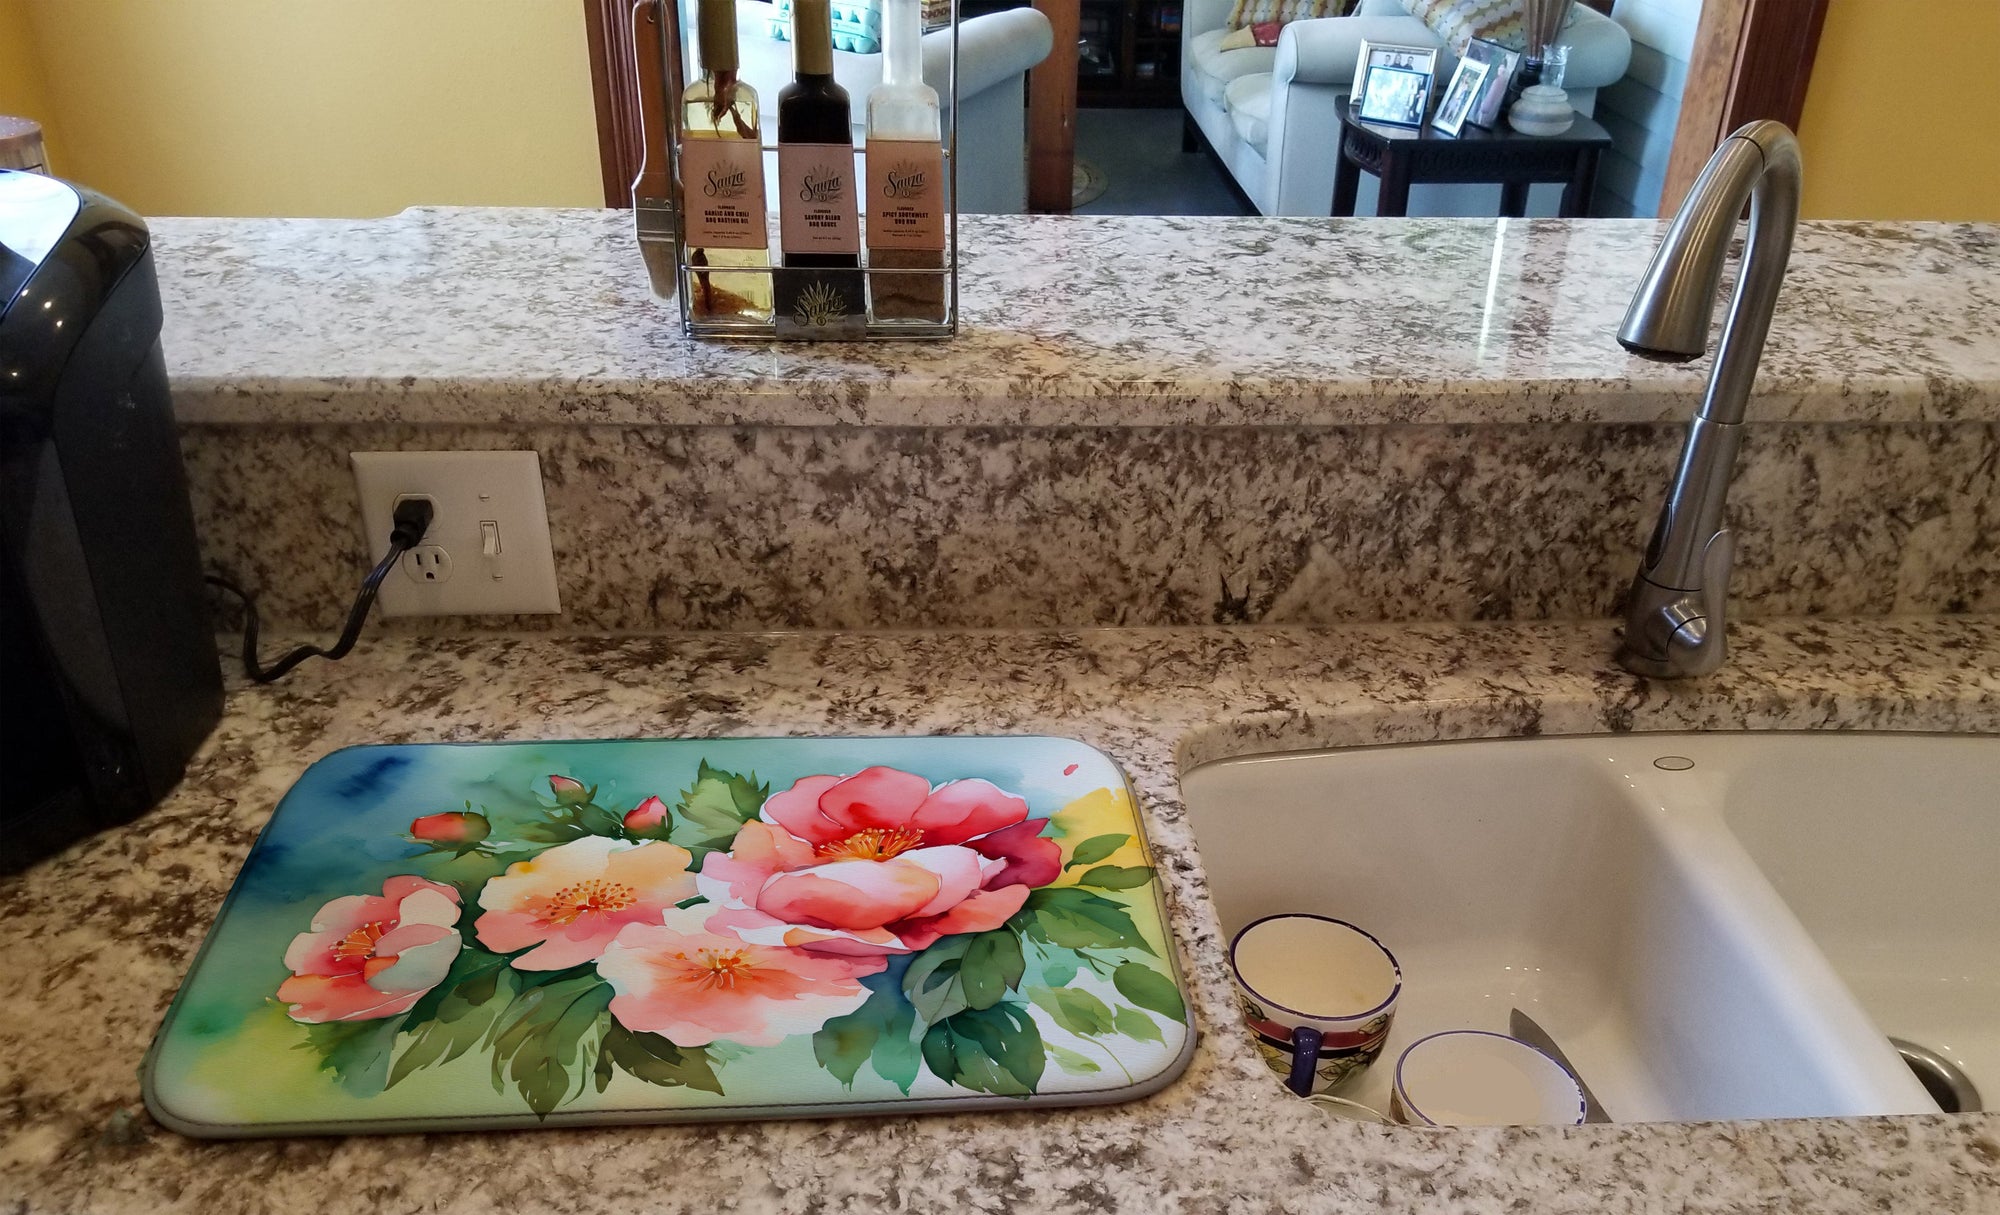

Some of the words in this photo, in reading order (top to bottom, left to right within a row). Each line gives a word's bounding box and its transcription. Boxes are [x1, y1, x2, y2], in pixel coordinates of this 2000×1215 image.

[704, 171, 745, 197] Sauza
[800, 176, 841, 202] Sauza
[884, 172, 925, 198] Sauza
